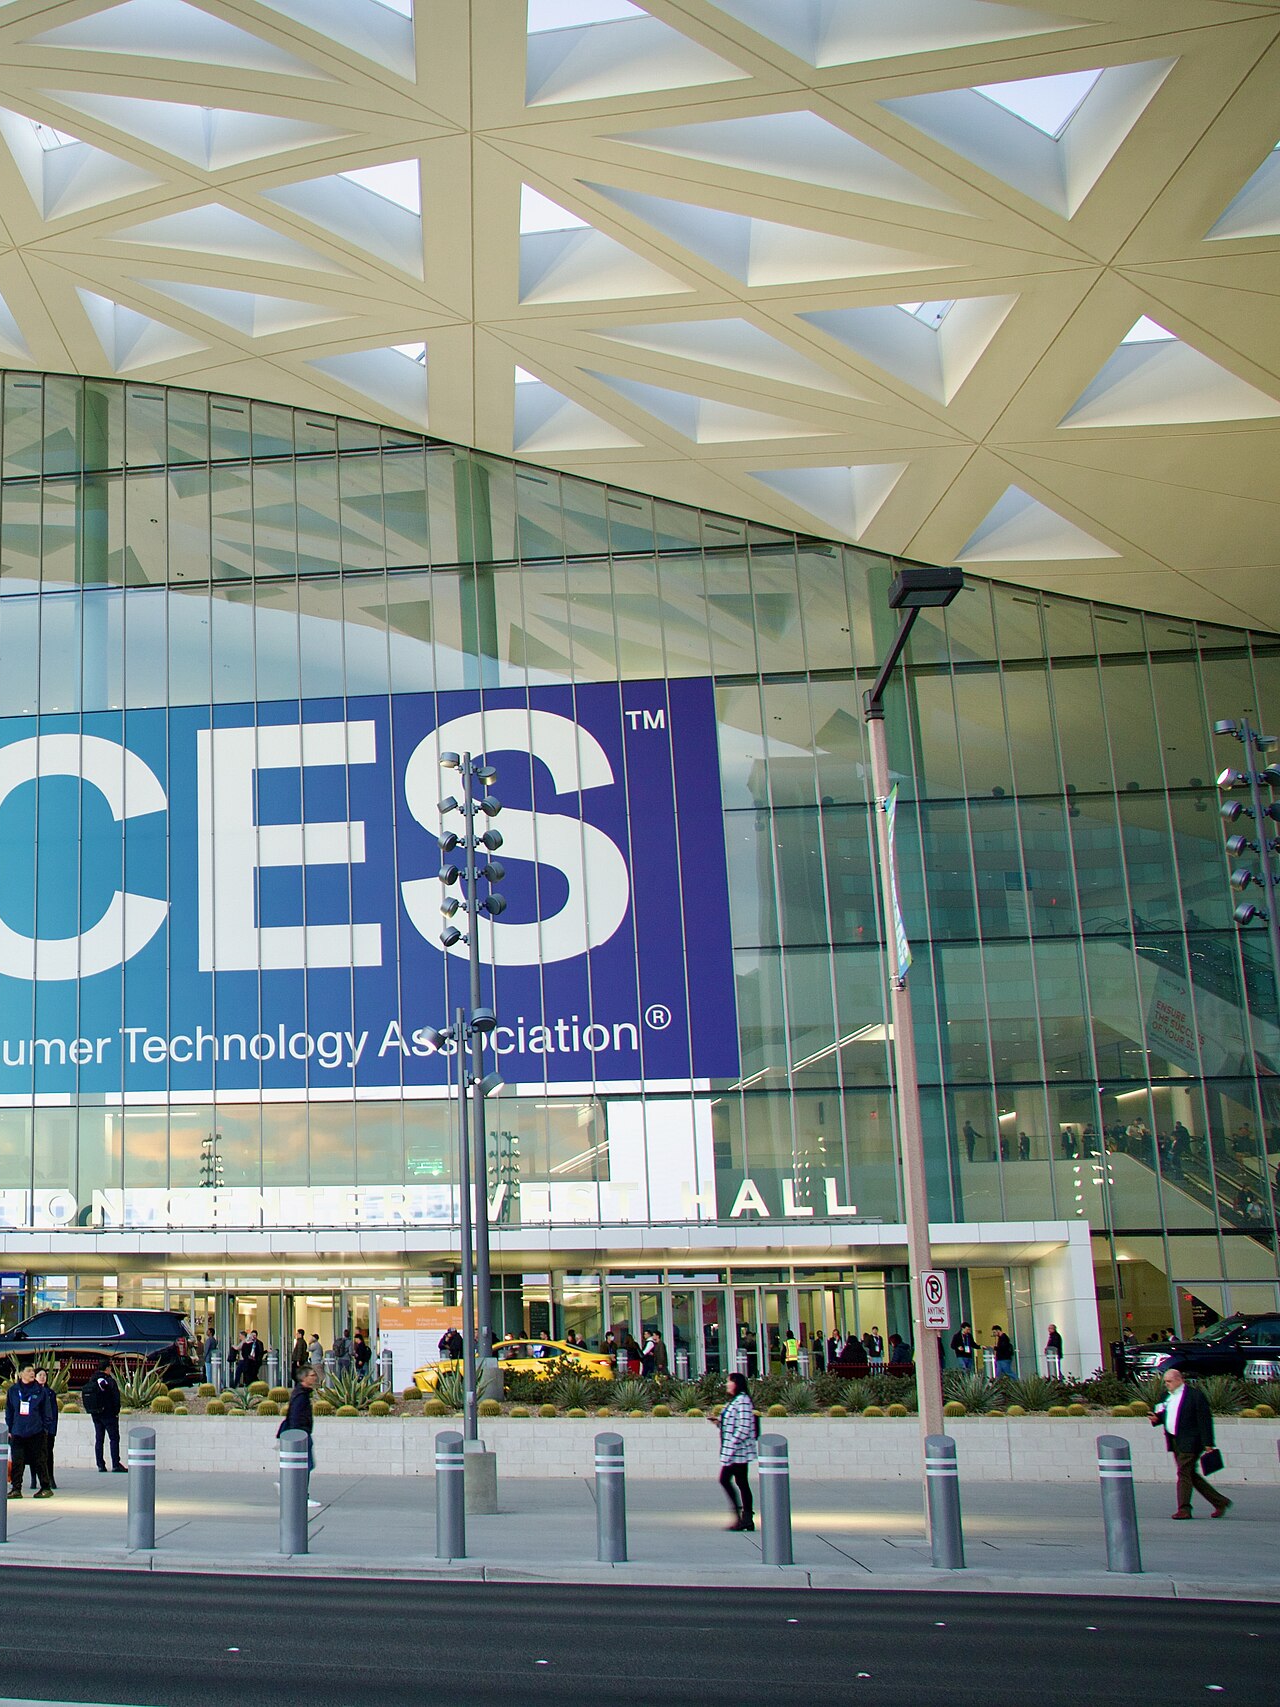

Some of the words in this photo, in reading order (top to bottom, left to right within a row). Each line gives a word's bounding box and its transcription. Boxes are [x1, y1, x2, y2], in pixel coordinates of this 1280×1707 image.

[1156, 1001, 1186, 1023] ENSURE
[118, 1023, 369, 1069] Technology
[161, 1187, 417, 1224] CENTER
[680, 1177, 858, 1219] HALL
